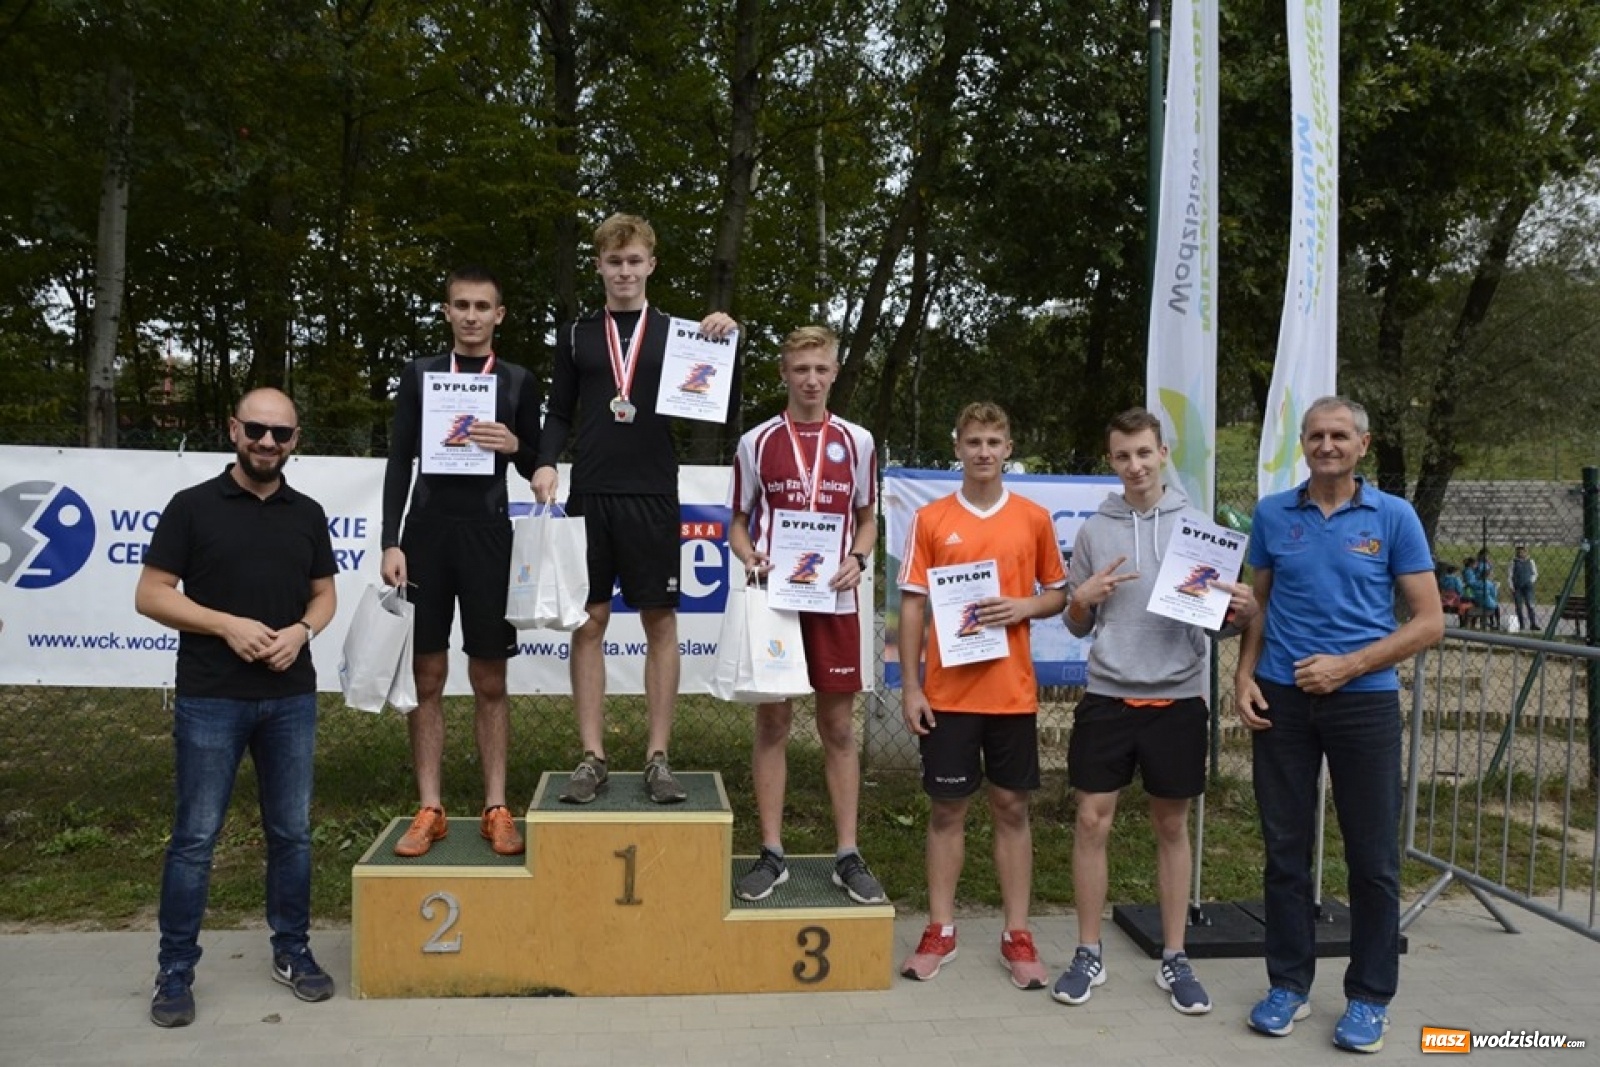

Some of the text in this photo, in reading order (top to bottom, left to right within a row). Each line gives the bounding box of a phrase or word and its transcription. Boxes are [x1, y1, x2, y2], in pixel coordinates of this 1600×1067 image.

[432, 383, 489, 393] DYPLOM
[781, 519, 836, 532] DYPLOM
[1182, 526, 1239, 550] DYPLOM
[937, 570, 991, 586] DYPLOM
[28, 632, 177, 651] www.wck.wodz
[613, 844, 643, 905] 1
[420, 891, 462, 953] 2
[792, 925, 831, 984] 3
